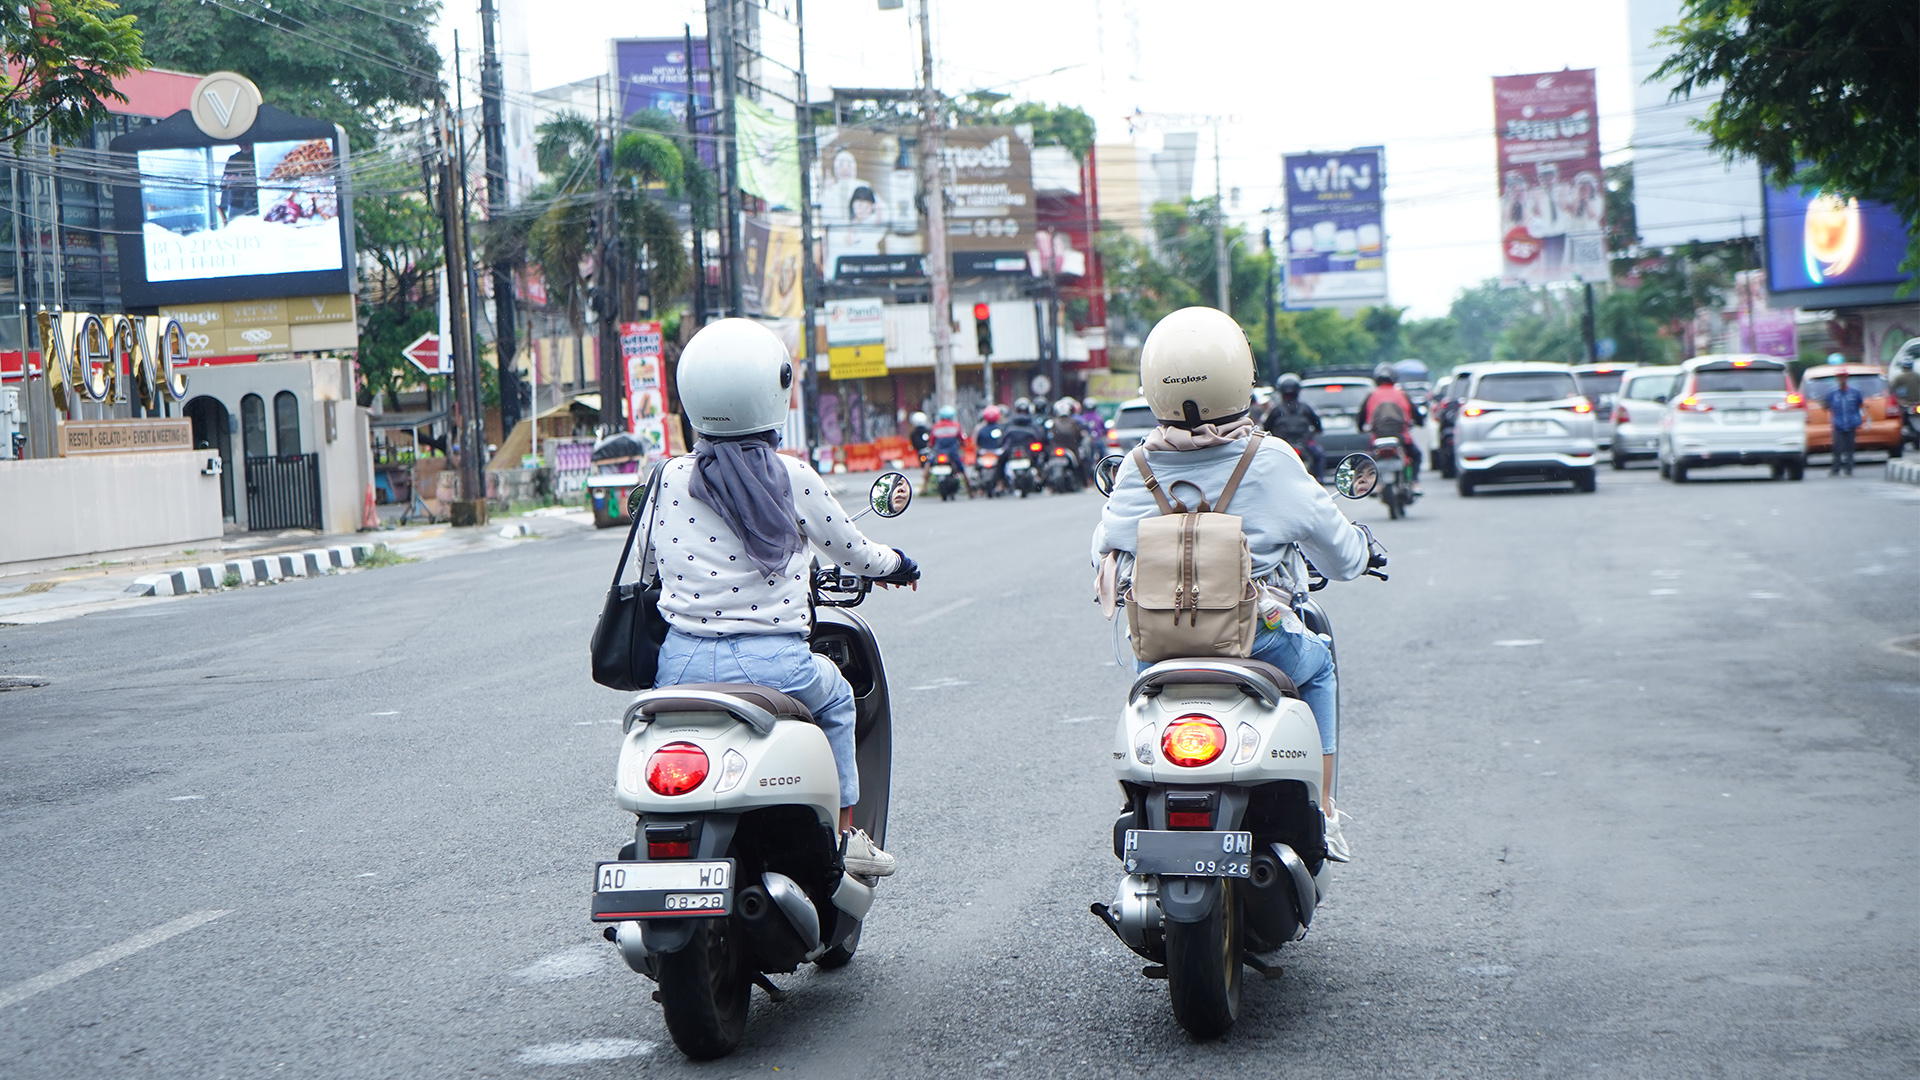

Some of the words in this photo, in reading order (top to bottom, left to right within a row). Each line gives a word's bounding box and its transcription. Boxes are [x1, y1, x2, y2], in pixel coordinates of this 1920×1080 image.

[1162, 374, 1208, 385] Cargloss
[68, 431, 89, 446] RESTO
[98, 432, 121, 446] GELATO
[133, 430, 151, 444] EVENT
[156, 428, 181, 443] MEETING
[1270, 749, 1308, 759] SCOOPY
[1126, 832, 1138, 851] H
[601, 869, 626, 890] AD
